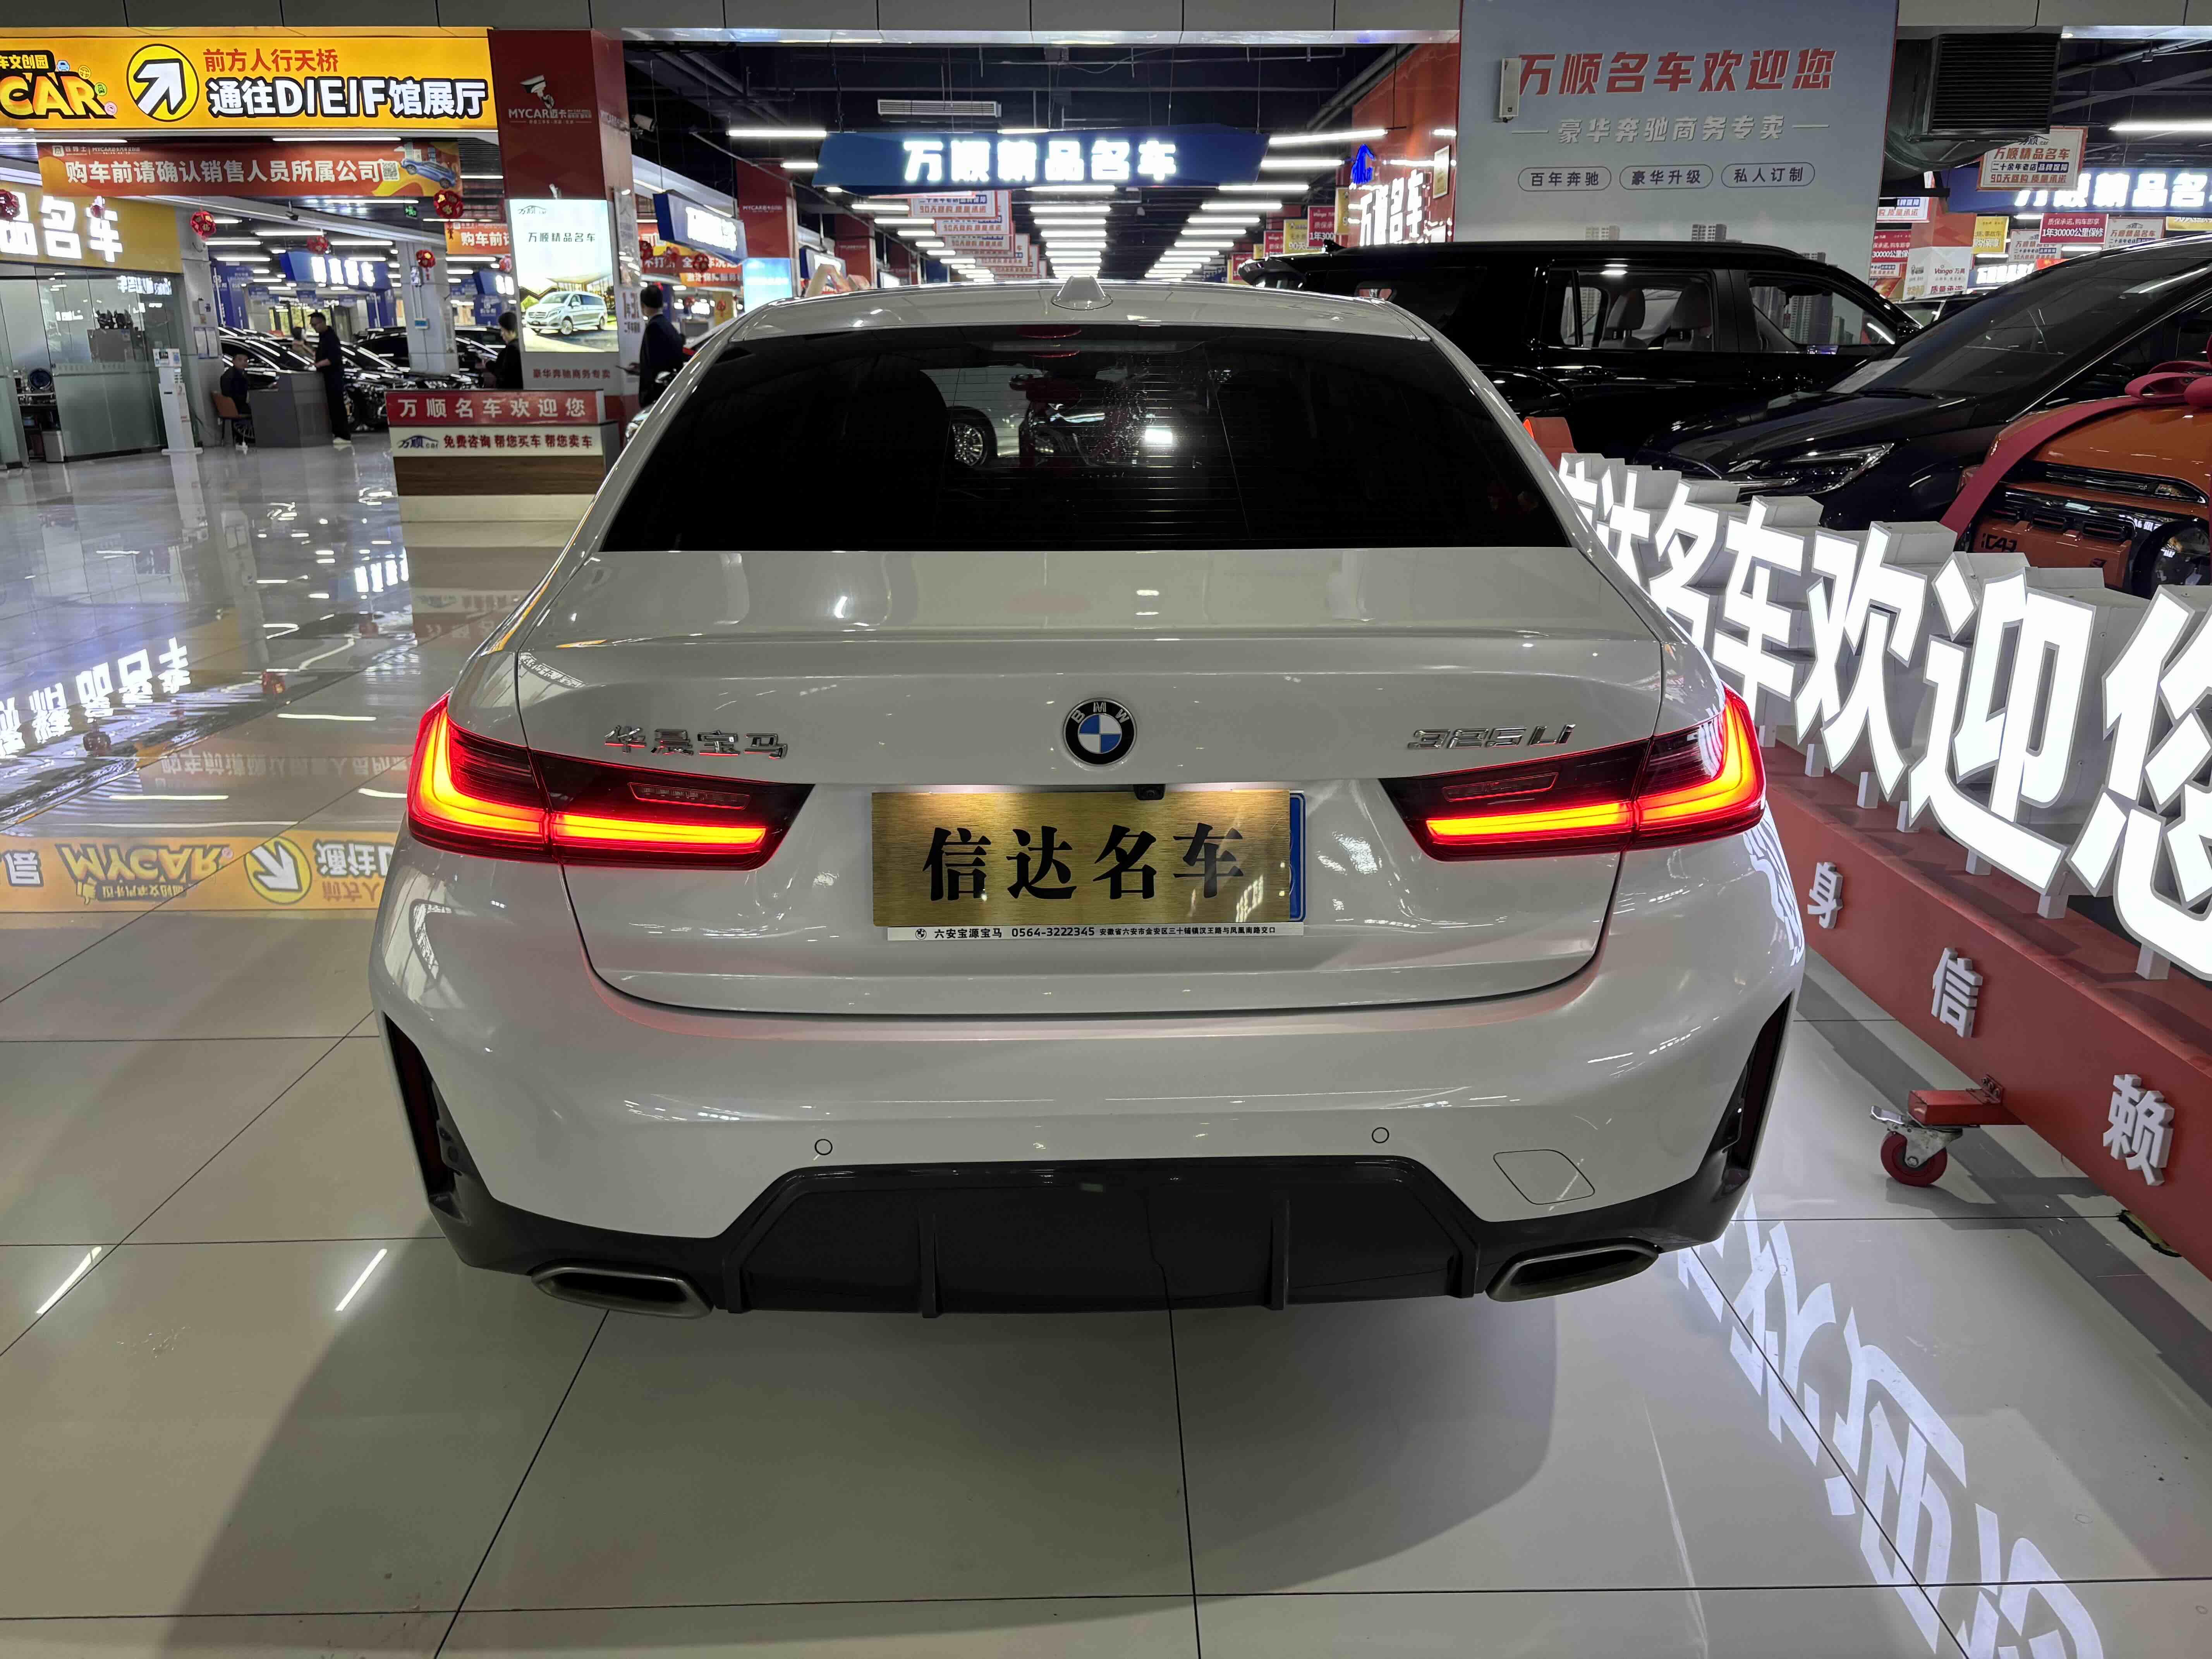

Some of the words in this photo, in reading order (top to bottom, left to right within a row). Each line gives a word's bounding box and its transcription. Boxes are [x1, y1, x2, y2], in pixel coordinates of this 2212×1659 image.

[0, 55, 49, 69] 车文创园
[203, 48, 338, 72] 前方人行天桥
[1519, 47, 1837, 95] 万顺名车欢迎您
[0, 76, 107, 116] CAR
[1558, 115, 1784, 143] 豪华奔驰商务专卖
[1994, 148, 2070, 160] 万顺精品名车
[65, 160, 381, 183] 购车前请确认销售人员所属公司
[1530, 171, 1599, 186] 百年奔驰
[1631, 170, 1701, 185] 豪华升级
[1734, 167, 1804, 183] 私人订制
[528, 232, 595, 242] 万顺精品名车
[2042, 228, 2104, 237] 1年30000公里保修
[533, 369, 611, 380] 豪华奔驰商务专卖
[398, 398, 586, 418] 万顺名车欢迎您
[443, 434, 491, 448] 免费咨询
[494, 434, 541, 448] 帮您买车
[545, 434, 592, 448] 帮您卖车
[1071, 702, 1130, 724] BMW
[604, 725, 788, 759] 华晨宝马
[1407, 724, 1576, 749] 325Li
[922, 823, 1244, 902] 信达名车
[934, 928, 1002, 939] 六安宝源宝马
[1012, 927, 1095, 937] 0564-3222345
